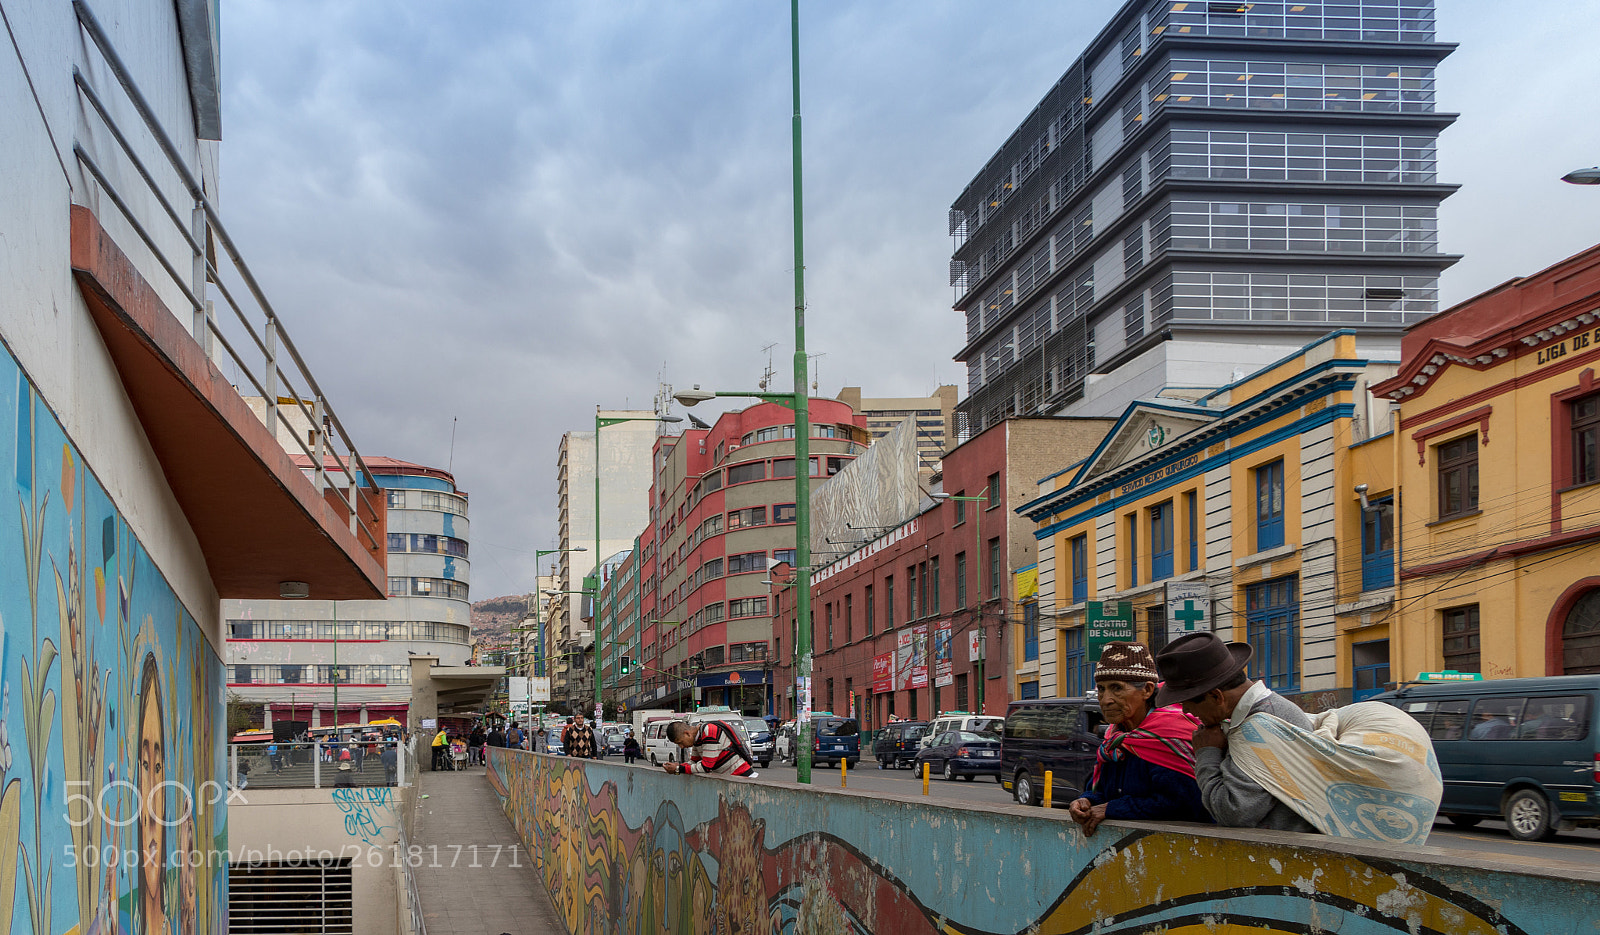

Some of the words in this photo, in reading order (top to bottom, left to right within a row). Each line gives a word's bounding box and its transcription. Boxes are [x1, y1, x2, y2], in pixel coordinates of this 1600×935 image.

[1537, 342, 1567, 365] LIGA
[1573, 332, 1590, 351] DE
[1121, 478, 1144, 494] SERVICIO
[1144, 470, 1164, 485] MEDICO
[1165, 455, 1198, 475] QUIRURGICO
[1089, 629, 1101, 637] DE
[1103, 629, 1132, 637] SALUD
[1093, 620, 1128, 628] CENTRO
[1379, 735, 1415, 753] PULSO
[1334, 789, 1414, 808] NIEVE
